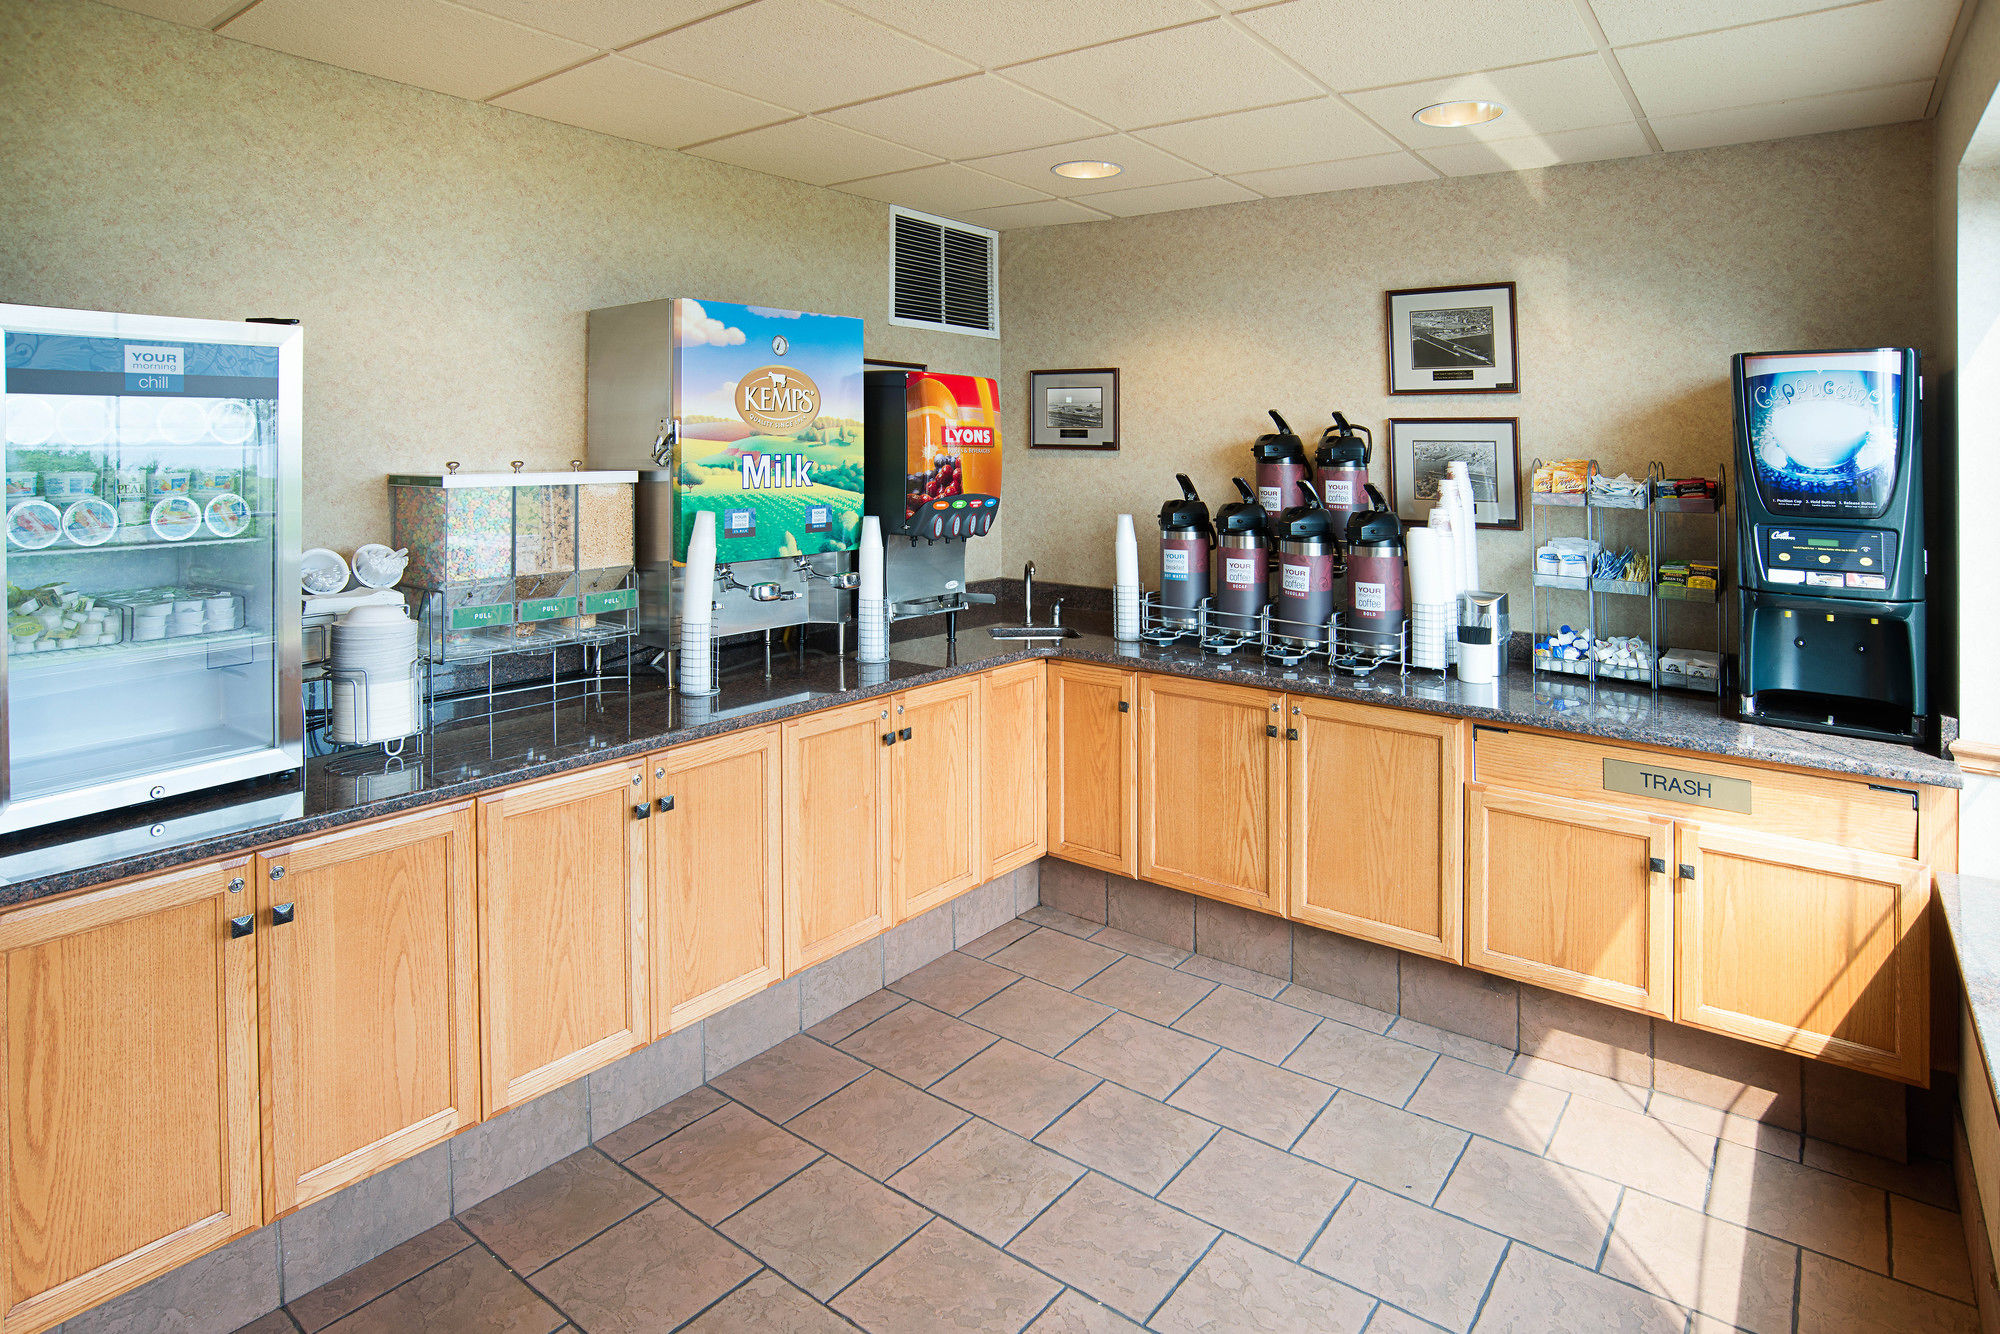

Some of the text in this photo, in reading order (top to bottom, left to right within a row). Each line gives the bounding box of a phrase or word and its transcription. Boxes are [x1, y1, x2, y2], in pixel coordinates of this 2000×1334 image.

[132, 352, 177, 363] YOUR
[132, 363, 177, 372] morning
[138, 375, 169, 389] chill
[744, 386, 815, 414] KEMPS
[749, 413, 774, 428] QUALITY
[945, 429, 991, 444] LYONS
[742, 453, 814, 490] Milk
[1329, 494, 1349, 502] coffee
[1284, 568, 1306, 576] YOUR
[1230, 573, 1251, 582] coffee
[1284, 580, 1305, 590] coffee
[1358, 586, 1381, 594] YOUR
[1358, 599, 1382, 609] coffee
[1640, 772, 1711, 799] TRASH
